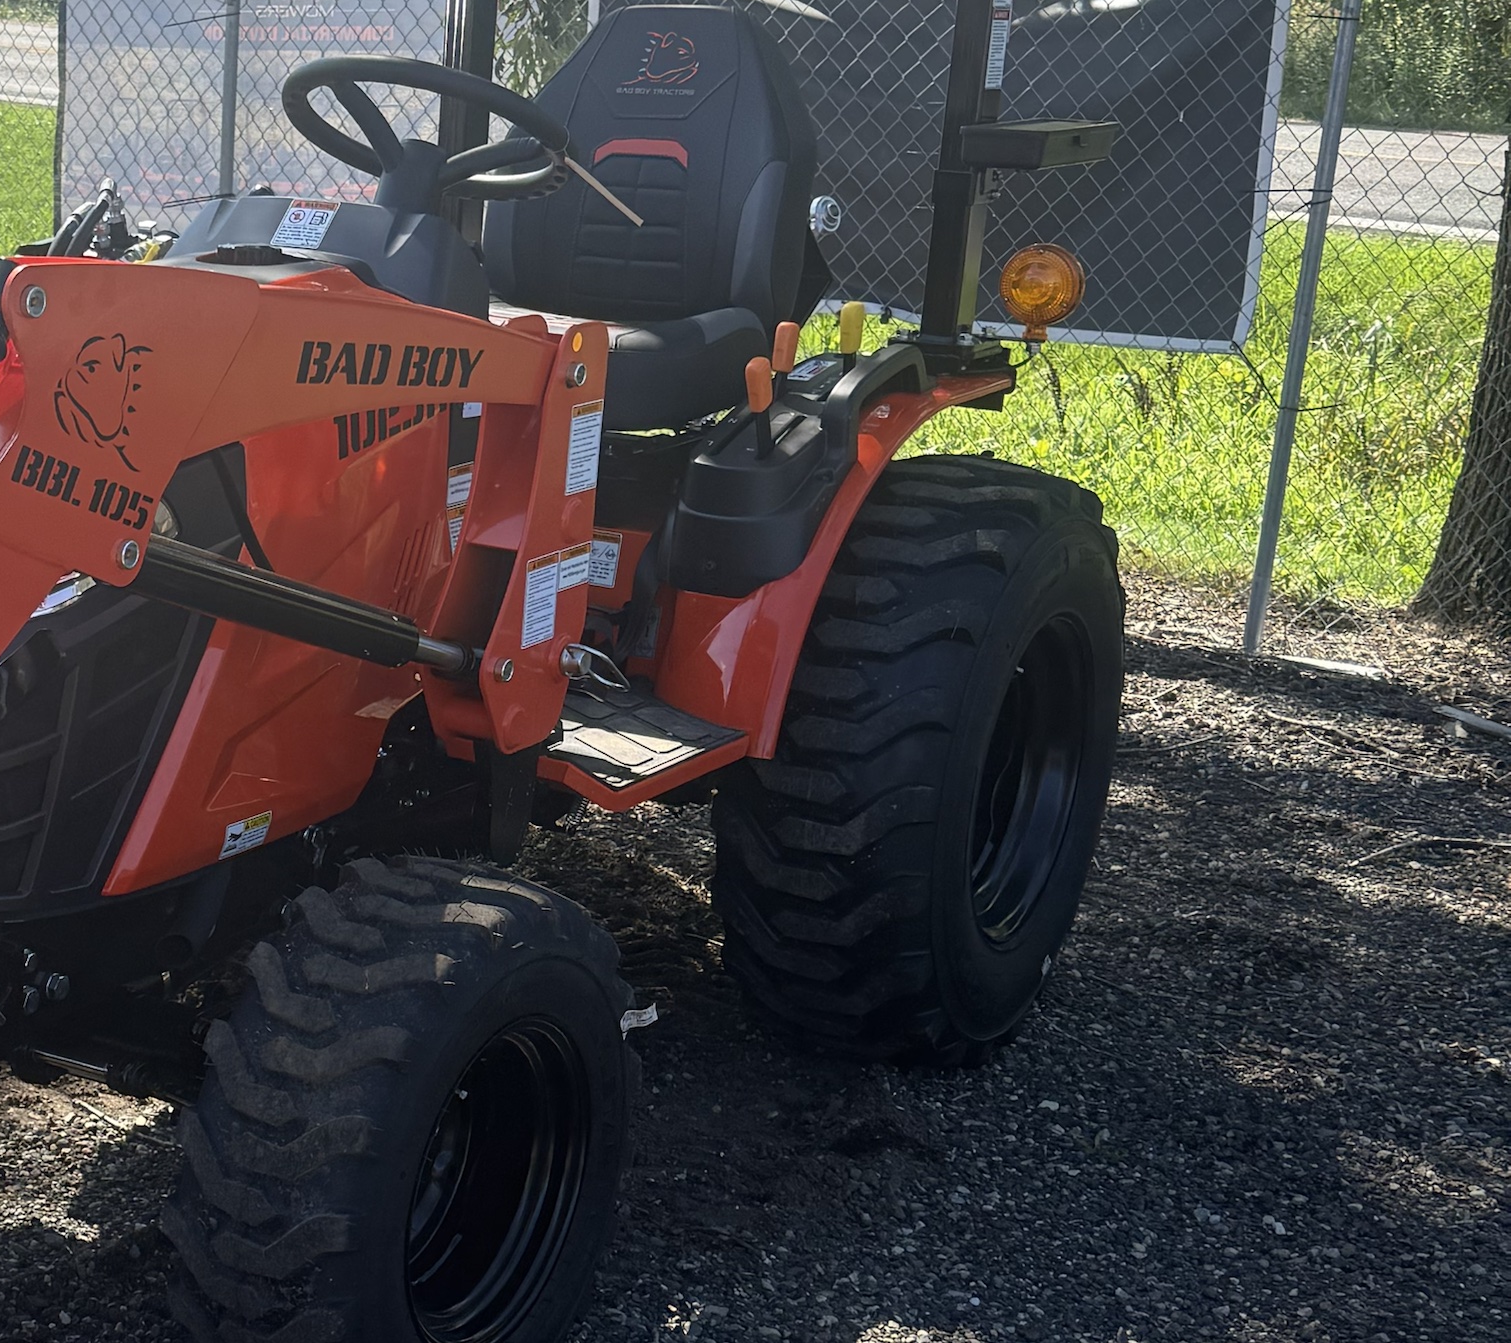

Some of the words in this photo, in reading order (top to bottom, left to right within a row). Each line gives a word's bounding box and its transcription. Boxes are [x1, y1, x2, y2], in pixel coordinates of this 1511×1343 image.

[296, 340, 392, 386] BAD
[396, 342, 485, 389] BOY
[10, 444, 81, 507] BBL
[87, 477, 154, 531] 105
